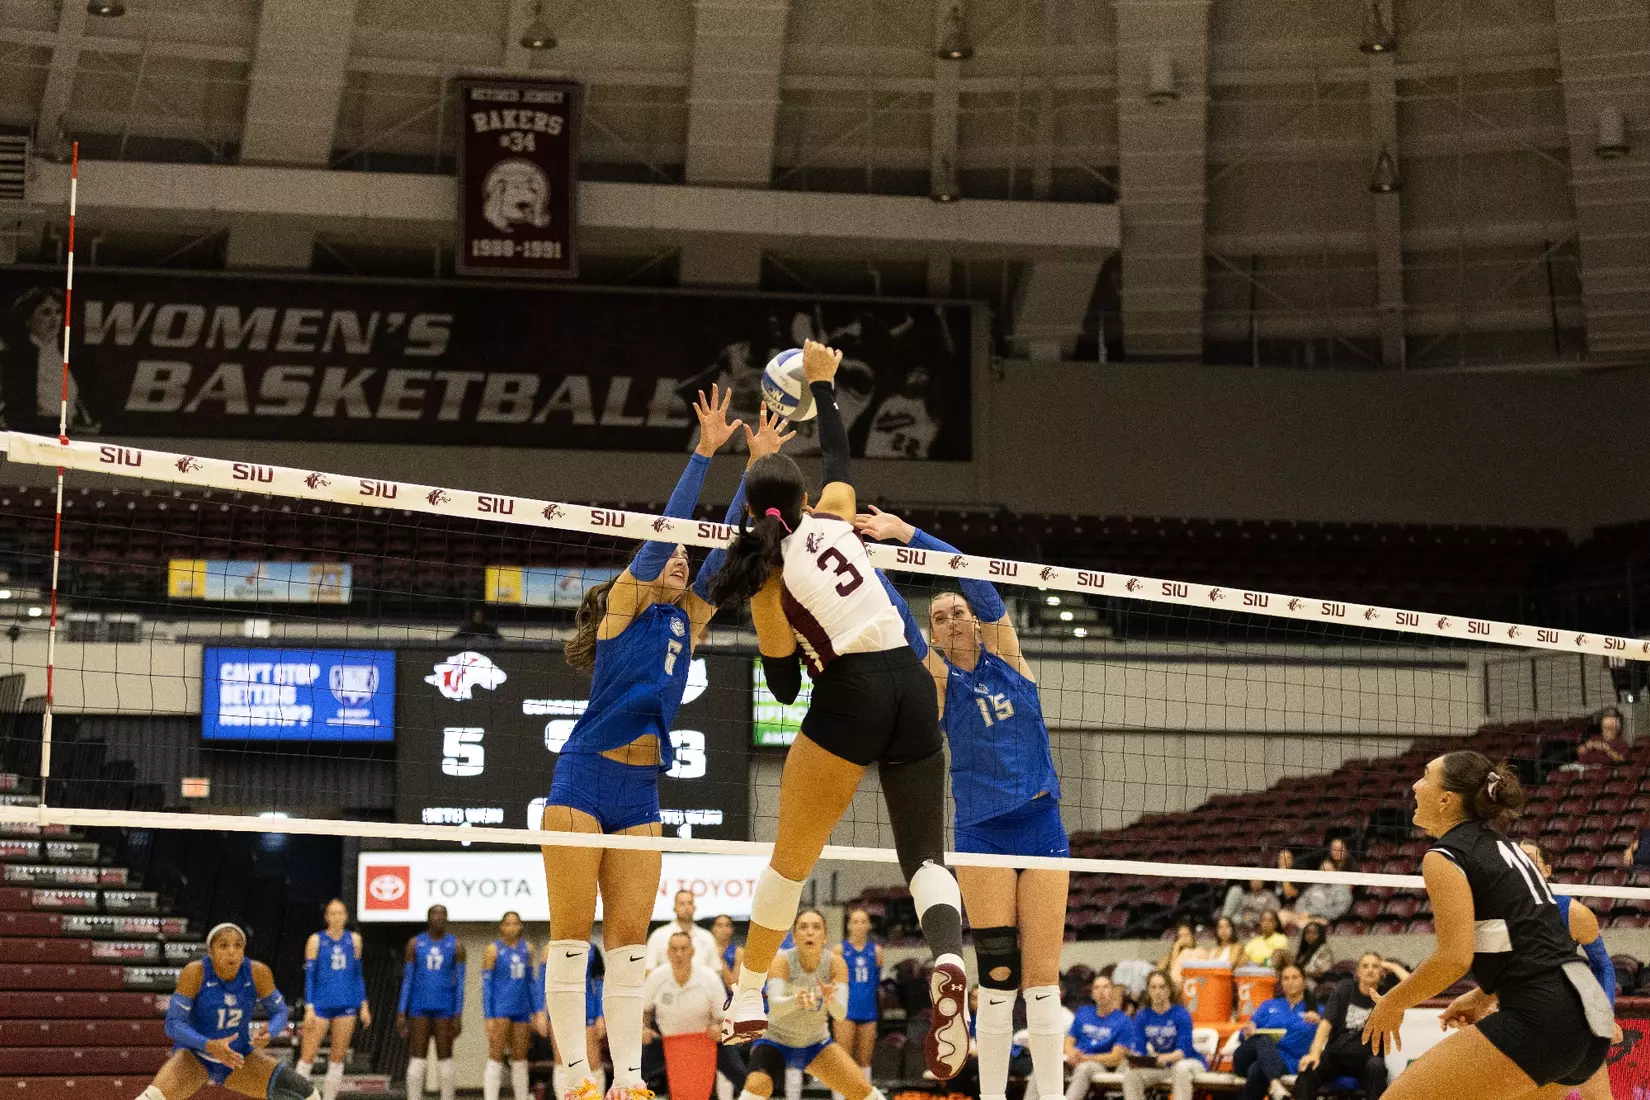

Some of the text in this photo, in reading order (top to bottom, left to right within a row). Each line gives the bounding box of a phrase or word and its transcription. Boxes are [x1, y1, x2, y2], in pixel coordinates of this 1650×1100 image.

[471, 108, 563, 136] RAKERS
[83, 301, 454, 357] WOMEN'S
[124, 359, 690, 428] BASKETBALL
[100, 446, 1626, 651] SIU SIU SIU SIU SIU SIU SIU SIU SIU SIU SIU SIU SIU SIU SIU SIU
[816, 546, 864, 598] 3
[975, 692, 1015, 728] 15
[442, 727, 485, 777] 5
[664, 729, 707, 779] 3
[423, 878, 532, 898] TOYOTA
[676, 878, 758, 898] TOYOT
[1495, 840, 1558, 905] 11
[216, 1007, 244, 1030] 12
